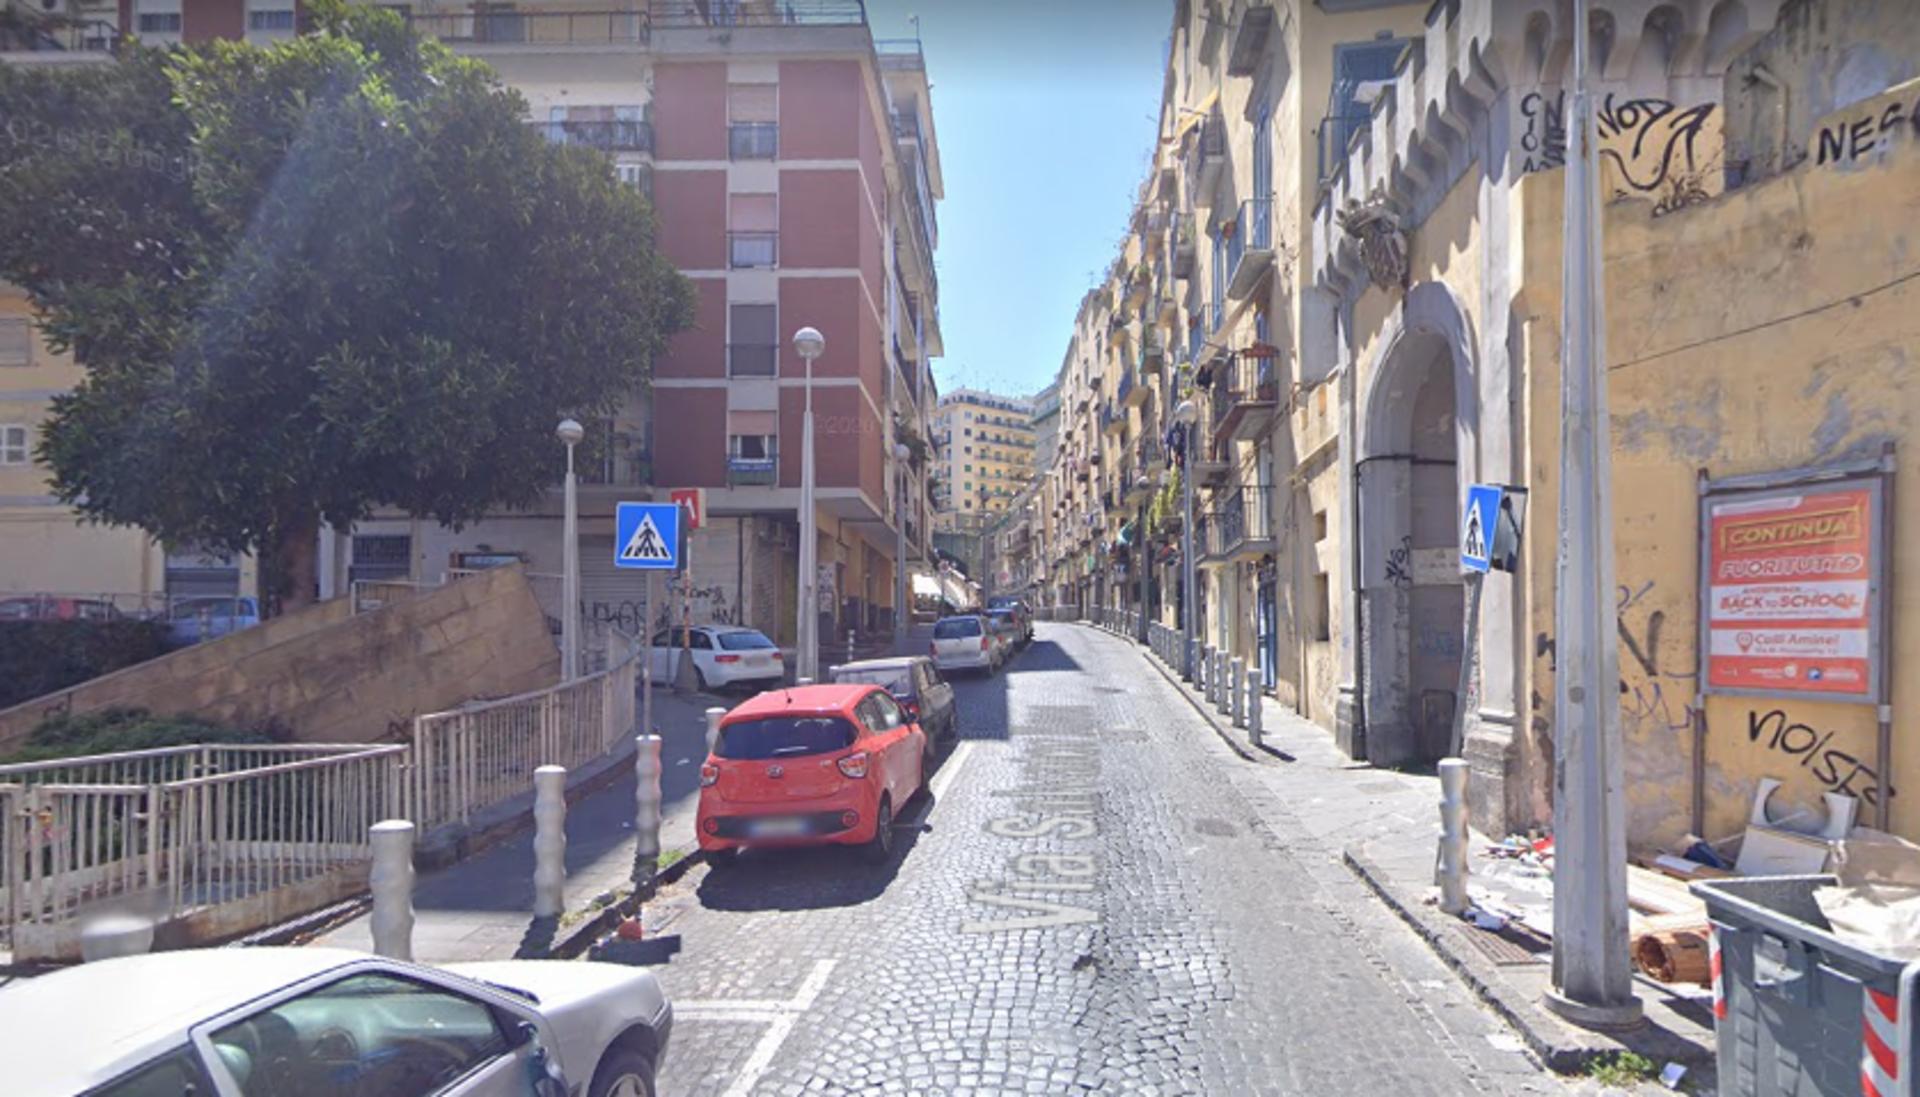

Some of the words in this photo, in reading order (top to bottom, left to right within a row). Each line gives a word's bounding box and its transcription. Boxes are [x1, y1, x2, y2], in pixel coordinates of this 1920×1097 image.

[1729, 517, 1849, 546] CONTINUA
[1719, 553, 1864, 578] FUORITUTTO
[1720, 595, 1763, 610] BACK
[1780, 591, 1860, 611] SCHOOL
